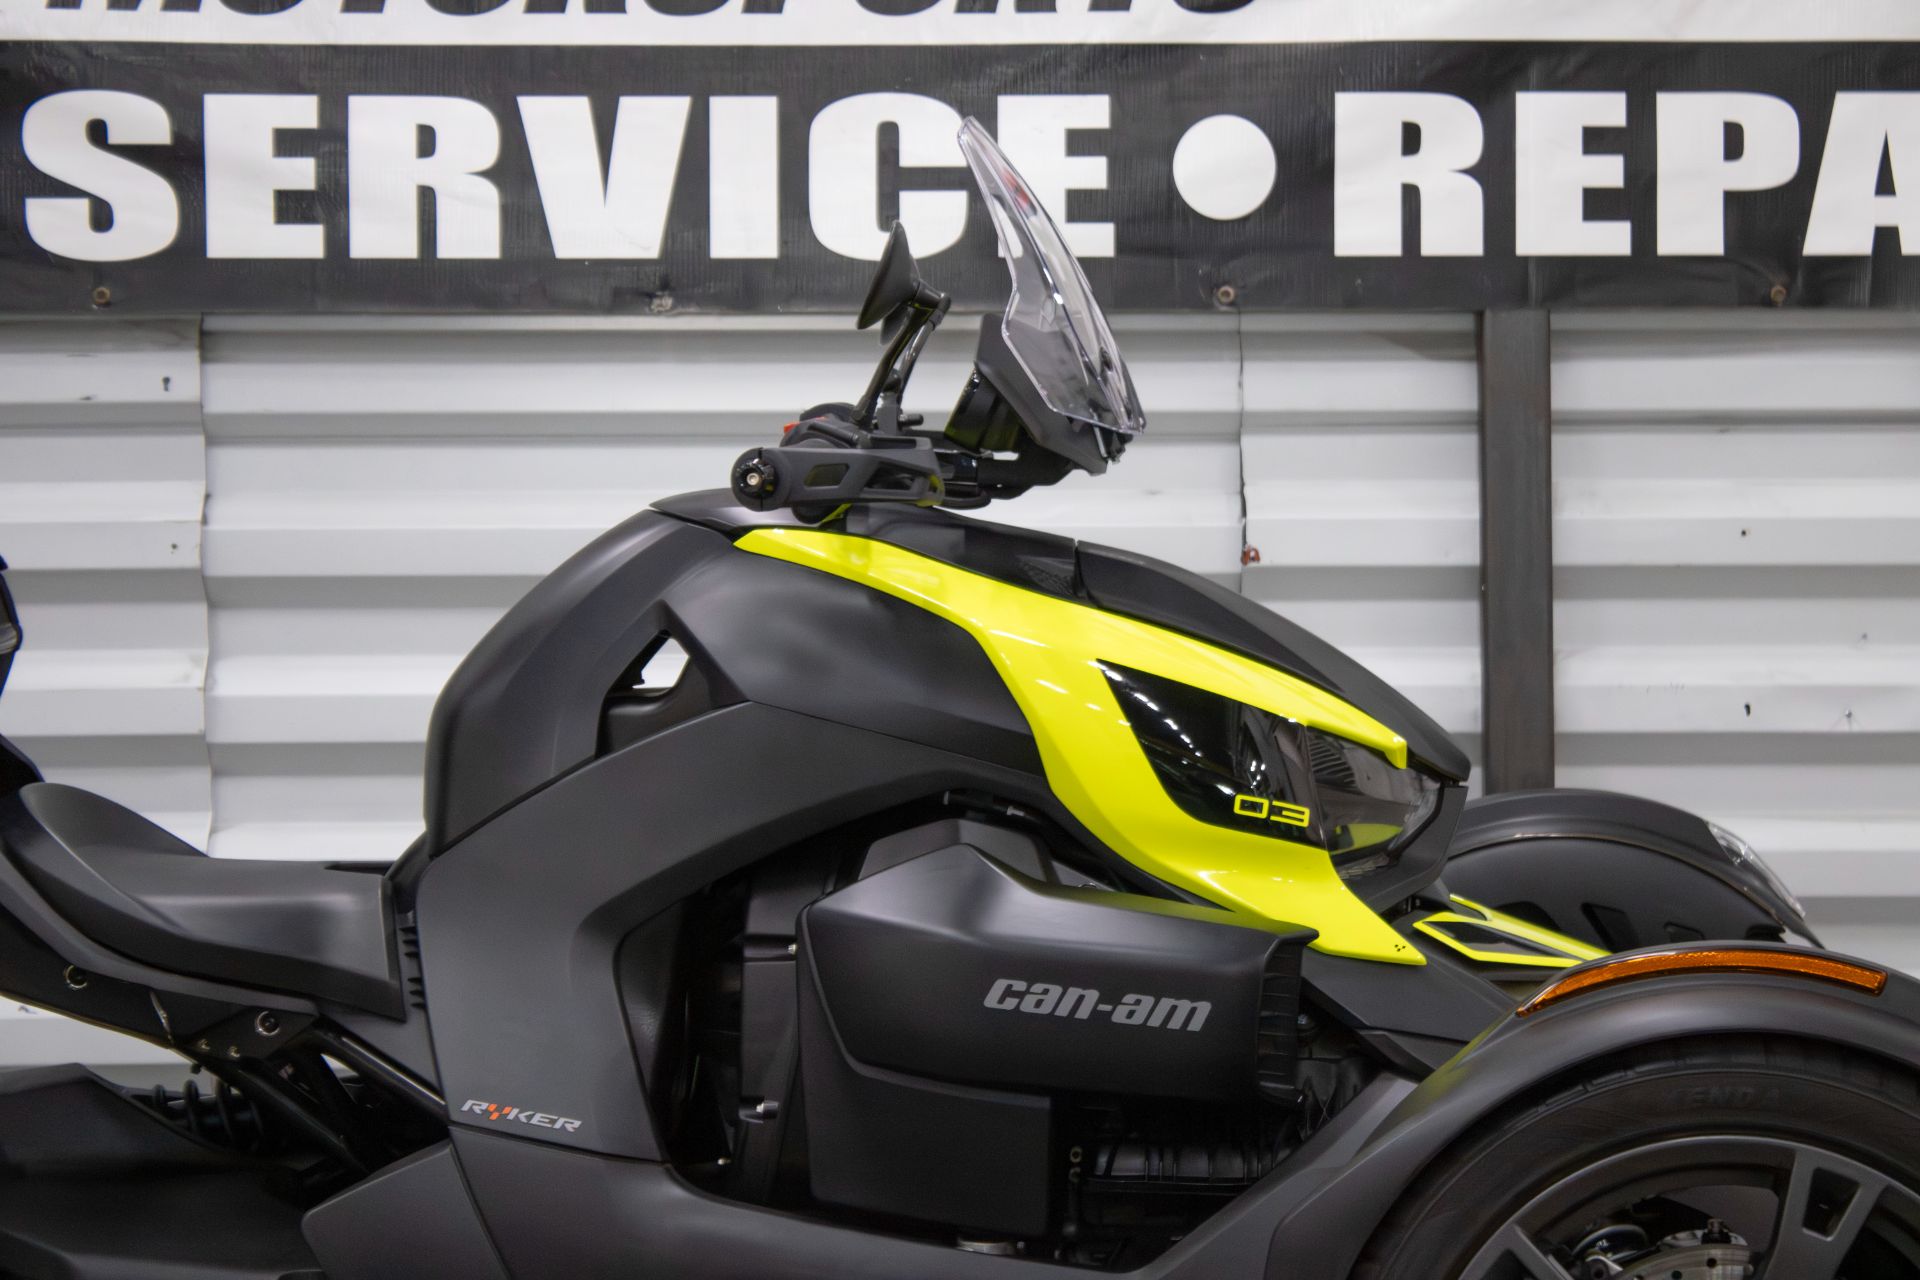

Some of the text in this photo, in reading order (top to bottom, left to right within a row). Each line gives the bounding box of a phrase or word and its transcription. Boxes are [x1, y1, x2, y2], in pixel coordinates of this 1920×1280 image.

[22, 89, 1920, 262] SERVICE REPA
[1233, 794, 1310, 828] 03
[983, 978, 1212, 1032] can-am
[460, 1099, 582, 1132] RYKER
